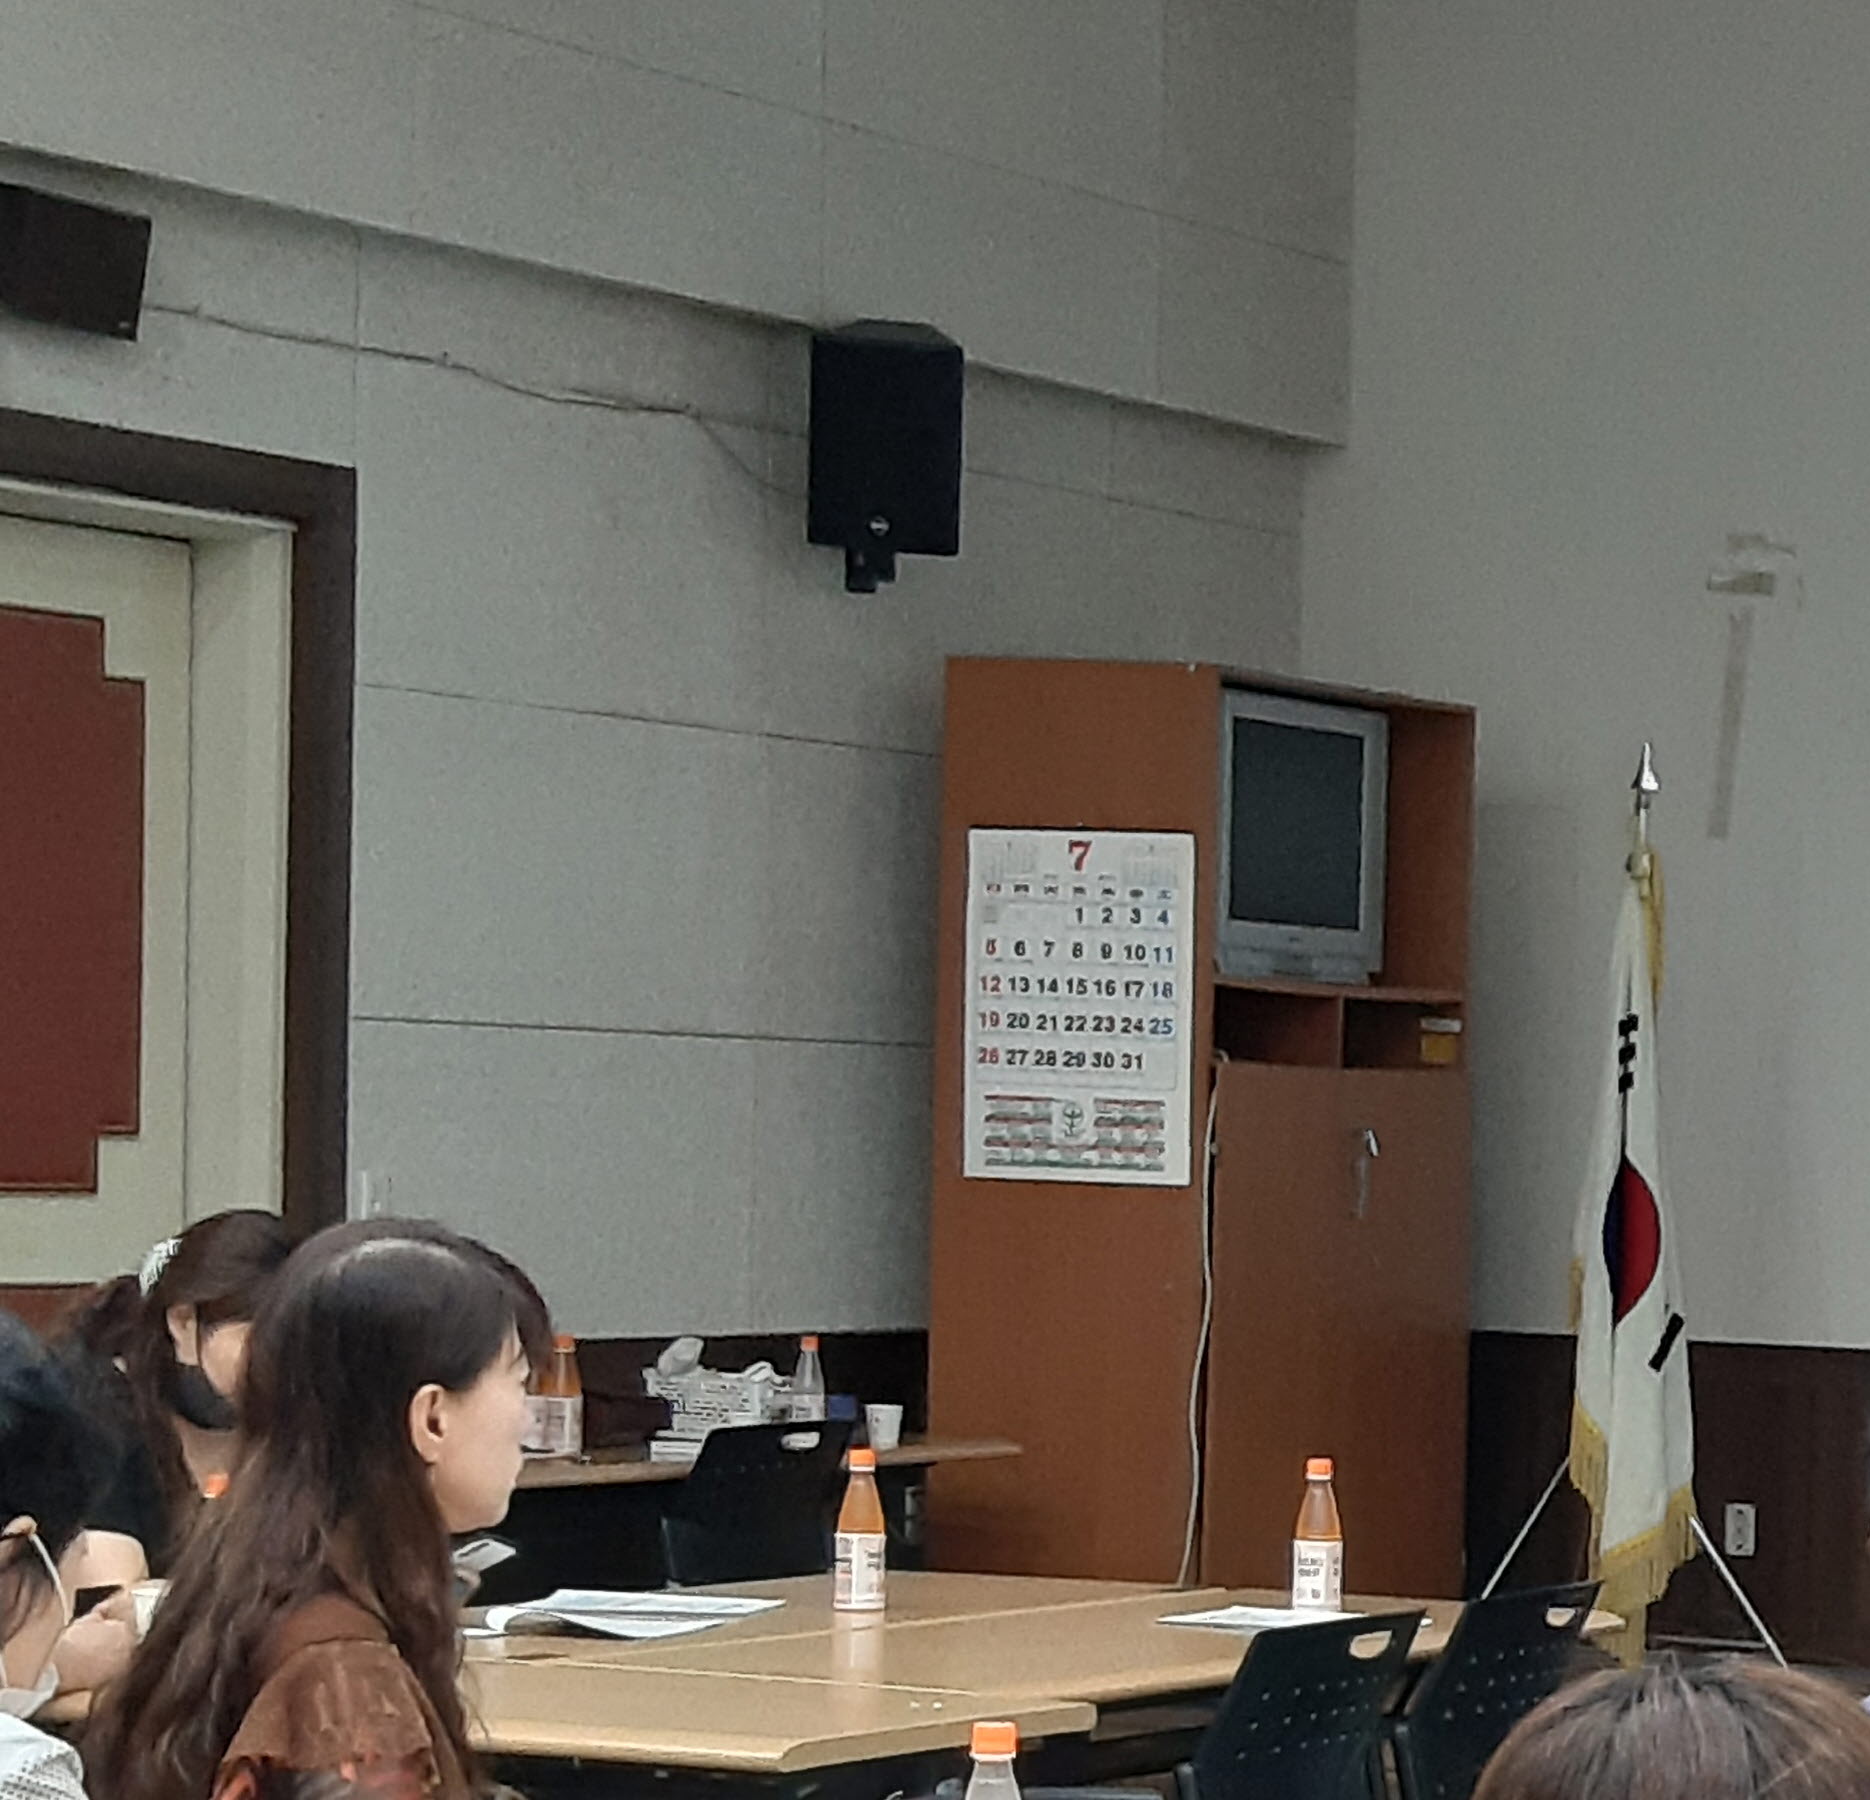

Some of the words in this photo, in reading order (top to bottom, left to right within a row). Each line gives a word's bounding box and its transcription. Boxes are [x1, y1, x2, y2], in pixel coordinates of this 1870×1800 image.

[1069, 840, 1092, 872] 7
[1075, 907, 1084, 924] 1
[1102, 907, 1113, 924] 2
[1130, 907, 1141, 924] 3
[1157, 909, 1169, 925] 4
[1014, 939, 1026, 956] 6
[1043, 940, 1055, 957] 7
[1072, 941, 1083, 959] 8
[1101, 942, 1112, 960] 9
[1124, 944, 1146, 961] 10
[1153, 946, 1173, 963] 11
[981, 975, 1000, 993] 12
[1008, 976, 1030, 993] 13
[1037, 977, 1059, 994] 14
[1066, 978, 1088, 996] 15
[1093, 979, 1116, 997] 16
[1125, 980, 1144, 998] 17
[1152, 981, 1173, 999] 18
[979, 1011, 1000, 1027] 19
[1006, 1012, 1030, 1029] 20
[1036, 1014, 1058, 1031] 21
[1064, 1015, 1085, 1032] 22
[1093, 1016, 1116, 1033] 23
[1121, 1016, 1144, 1034] 24
[1149, 1018, 1173, 1035] 25
[978, 1047, 999, 1065] 26
[1006, 1049, 1028, 1066] 27
[1034, 1049, 1057, 1067] 28
[1063, 1050, 1086, 1068] 29
[1091, 1051, 1115, 1068] 30
[1121, 1053, 1143, 1070] 31
